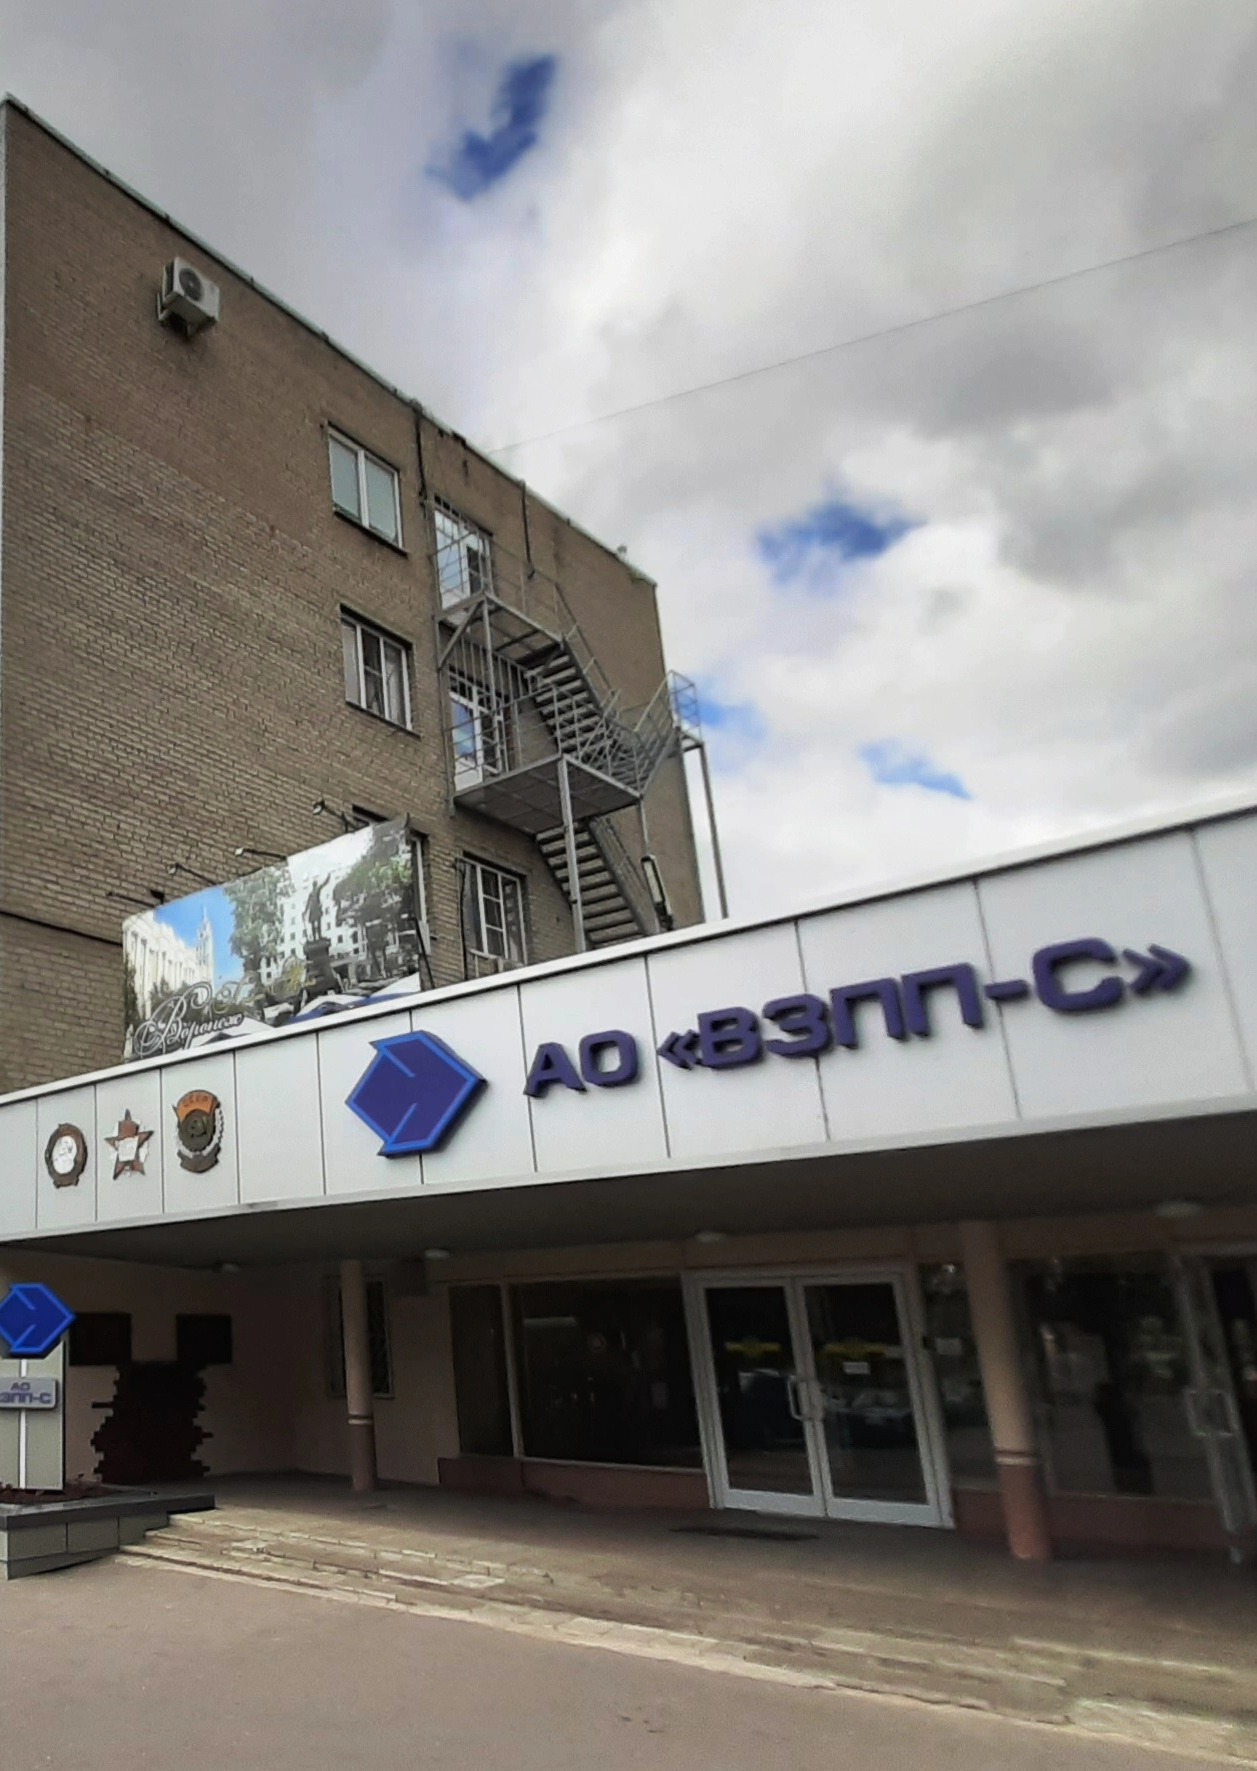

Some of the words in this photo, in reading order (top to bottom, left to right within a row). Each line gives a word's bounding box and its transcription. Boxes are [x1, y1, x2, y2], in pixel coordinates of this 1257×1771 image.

[524, 1030, 639, 1098] АО
[656, 938, 1193, 1071] «ВЗПП-С»
[10, 1382, 31, 1391] АО
